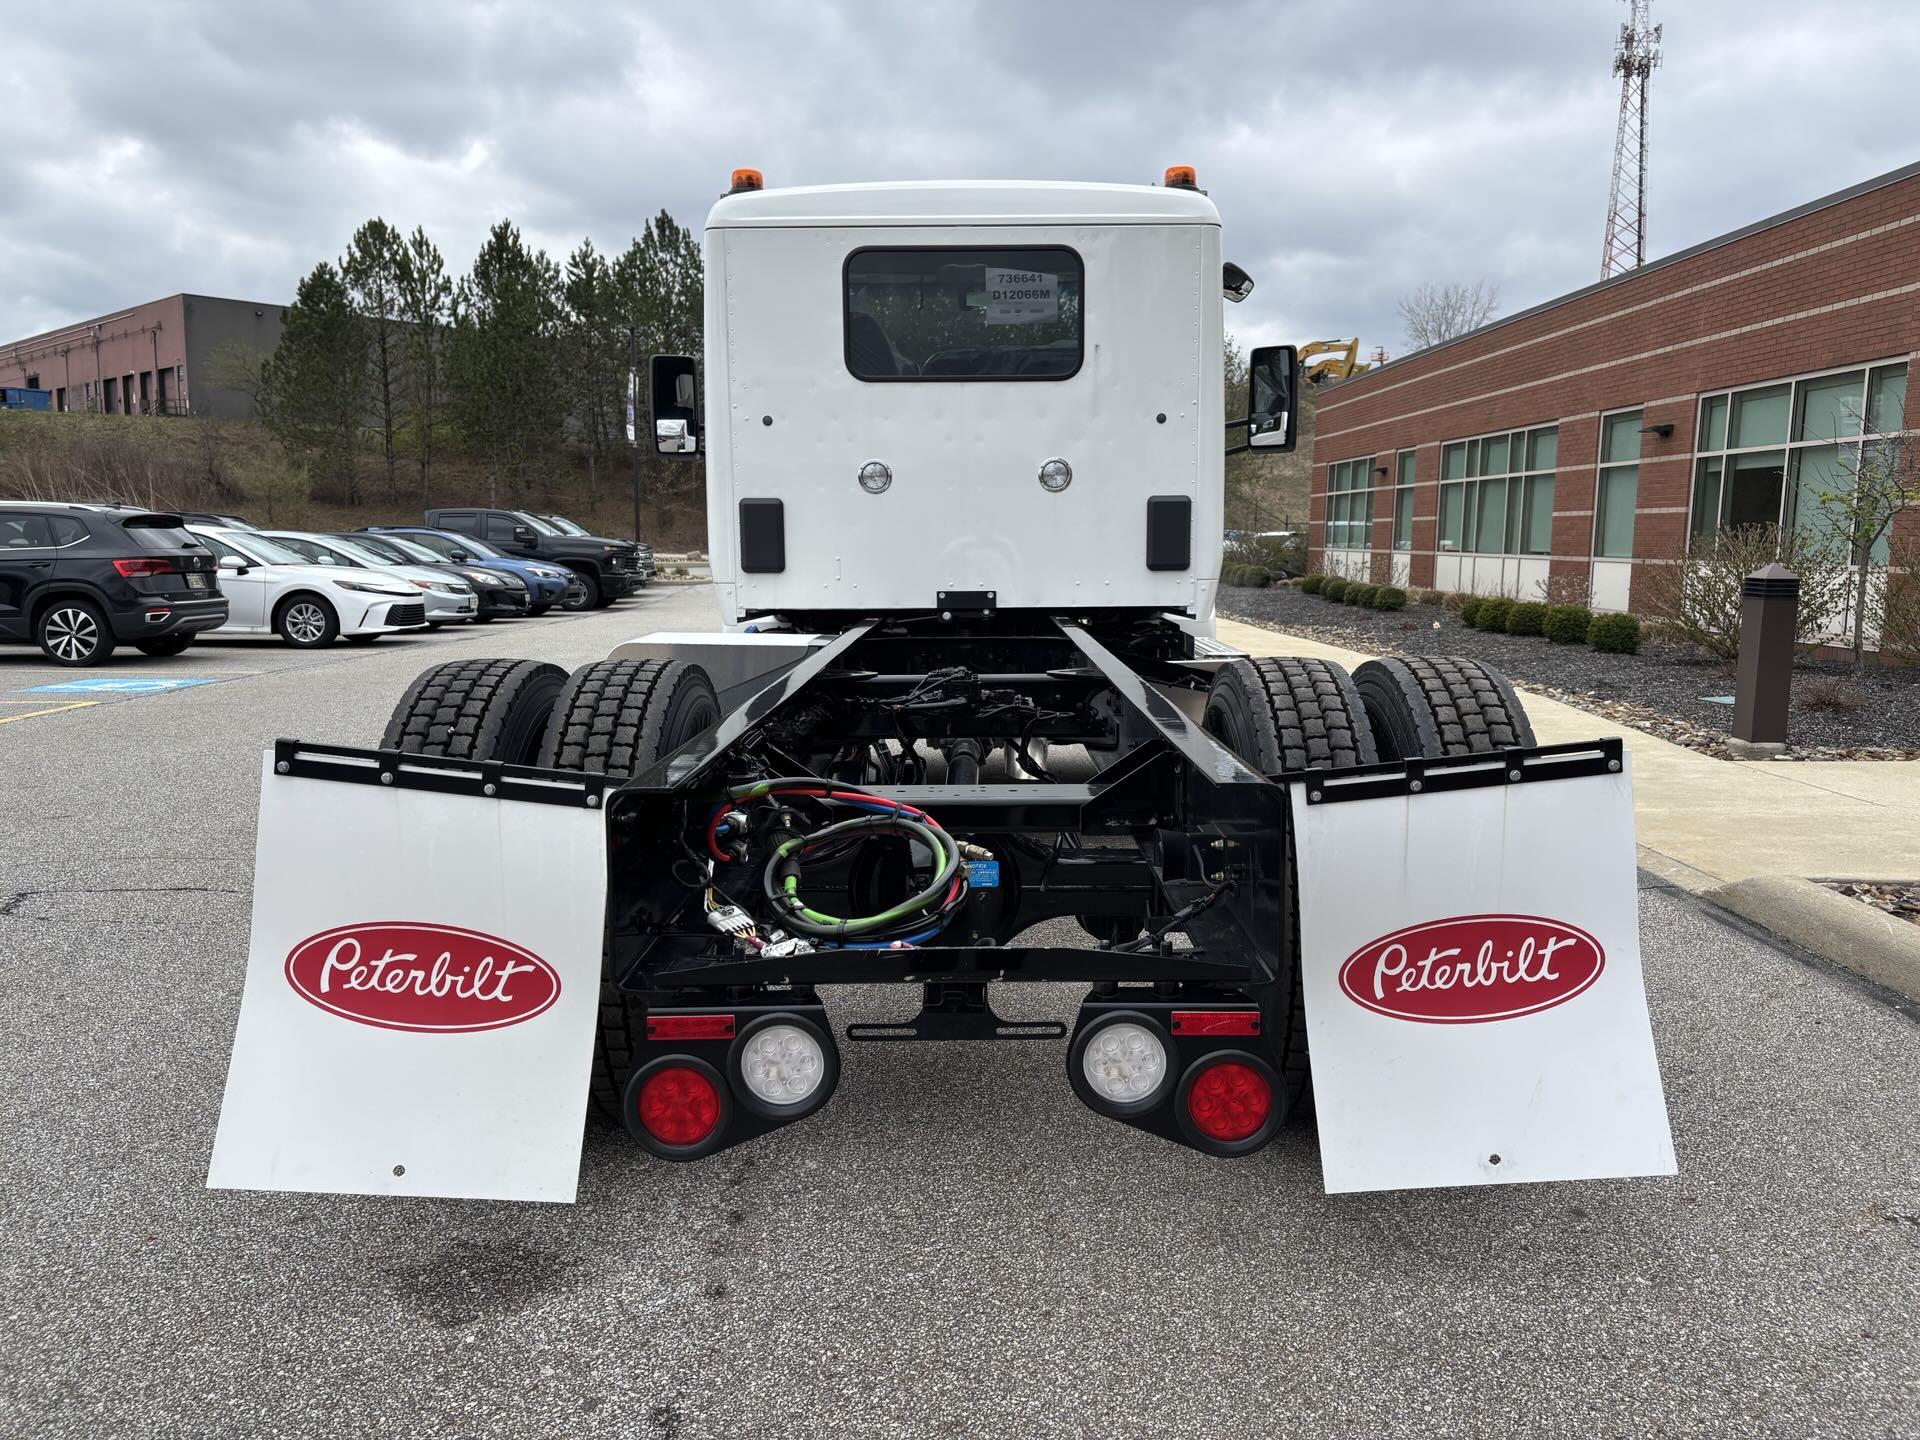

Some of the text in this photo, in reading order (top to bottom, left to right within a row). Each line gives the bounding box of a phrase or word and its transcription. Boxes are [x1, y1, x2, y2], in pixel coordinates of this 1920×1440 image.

[992, 290, 1050, 300] D12066M
[998, 273, 1043, 283] 736641
[319, 937, 536, 1002] Peterbilt
[1373, 936, 1577, 1000] Peterbilt
